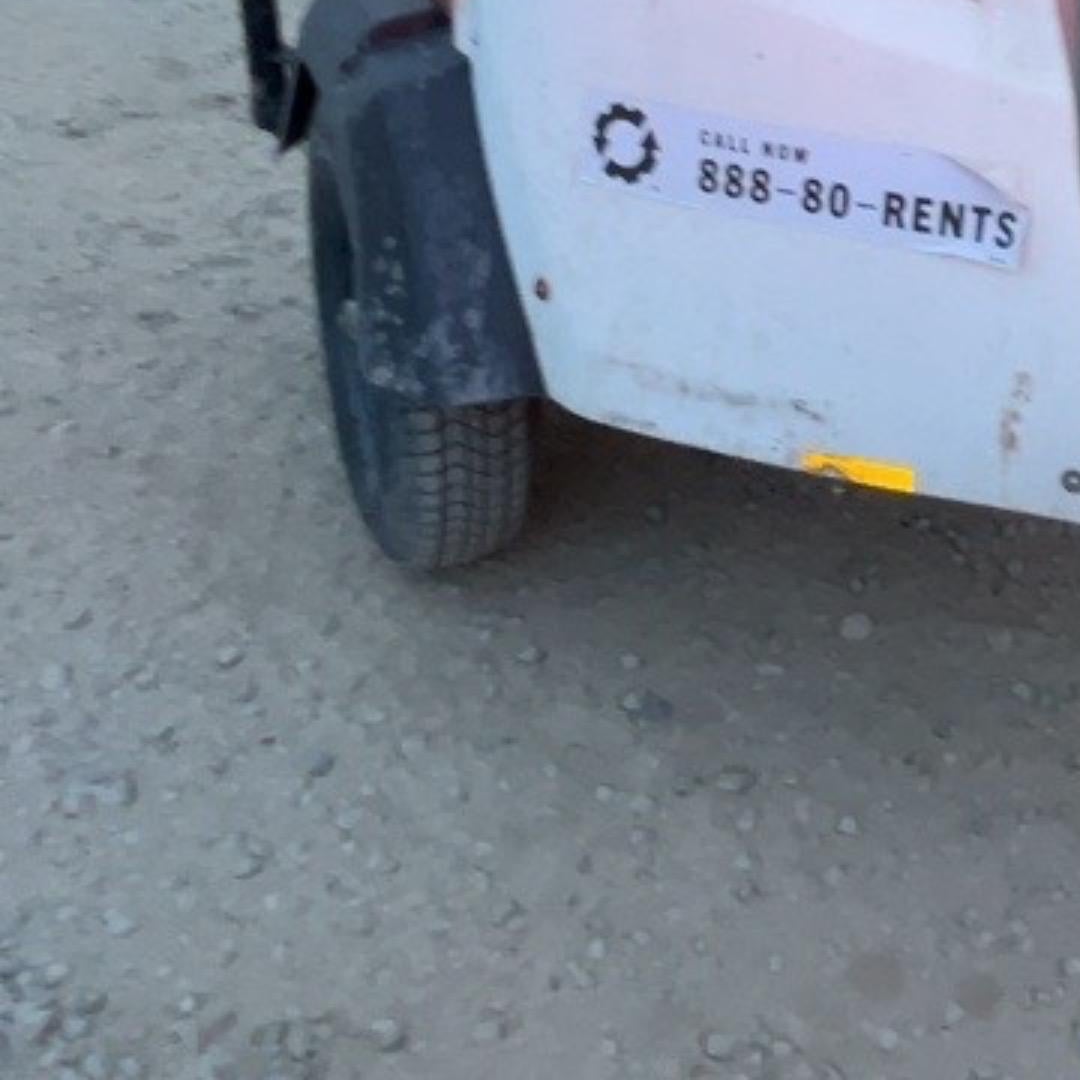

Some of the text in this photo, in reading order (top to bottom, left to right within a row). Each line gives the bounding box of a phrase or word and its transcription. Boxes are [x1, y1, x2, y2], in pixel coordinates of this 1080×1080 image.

[699, 129, 809, 164] CALL NOW
[698, 157, 1018, 250] 888-80-RENTS
